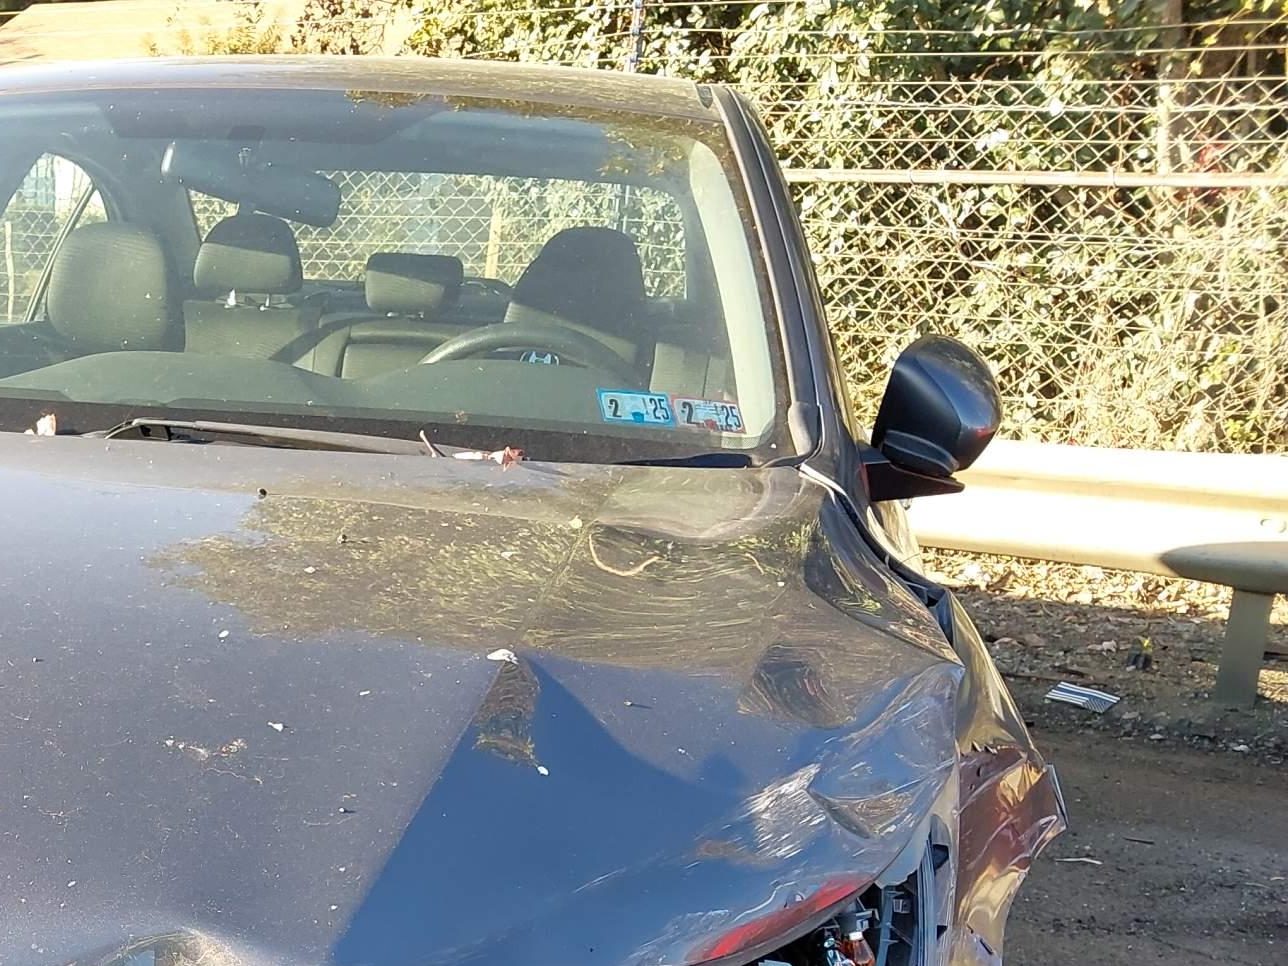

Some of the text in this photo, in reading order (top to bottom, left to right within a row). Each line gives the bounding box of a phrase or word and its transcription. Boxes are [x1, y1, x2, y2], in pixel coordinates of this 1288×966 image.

[610, 399, 622, 418] 2
[649, 397, 670, 420] 25
[682, 401, 700, 425] 2
[721, 405, 742, 429] 25
